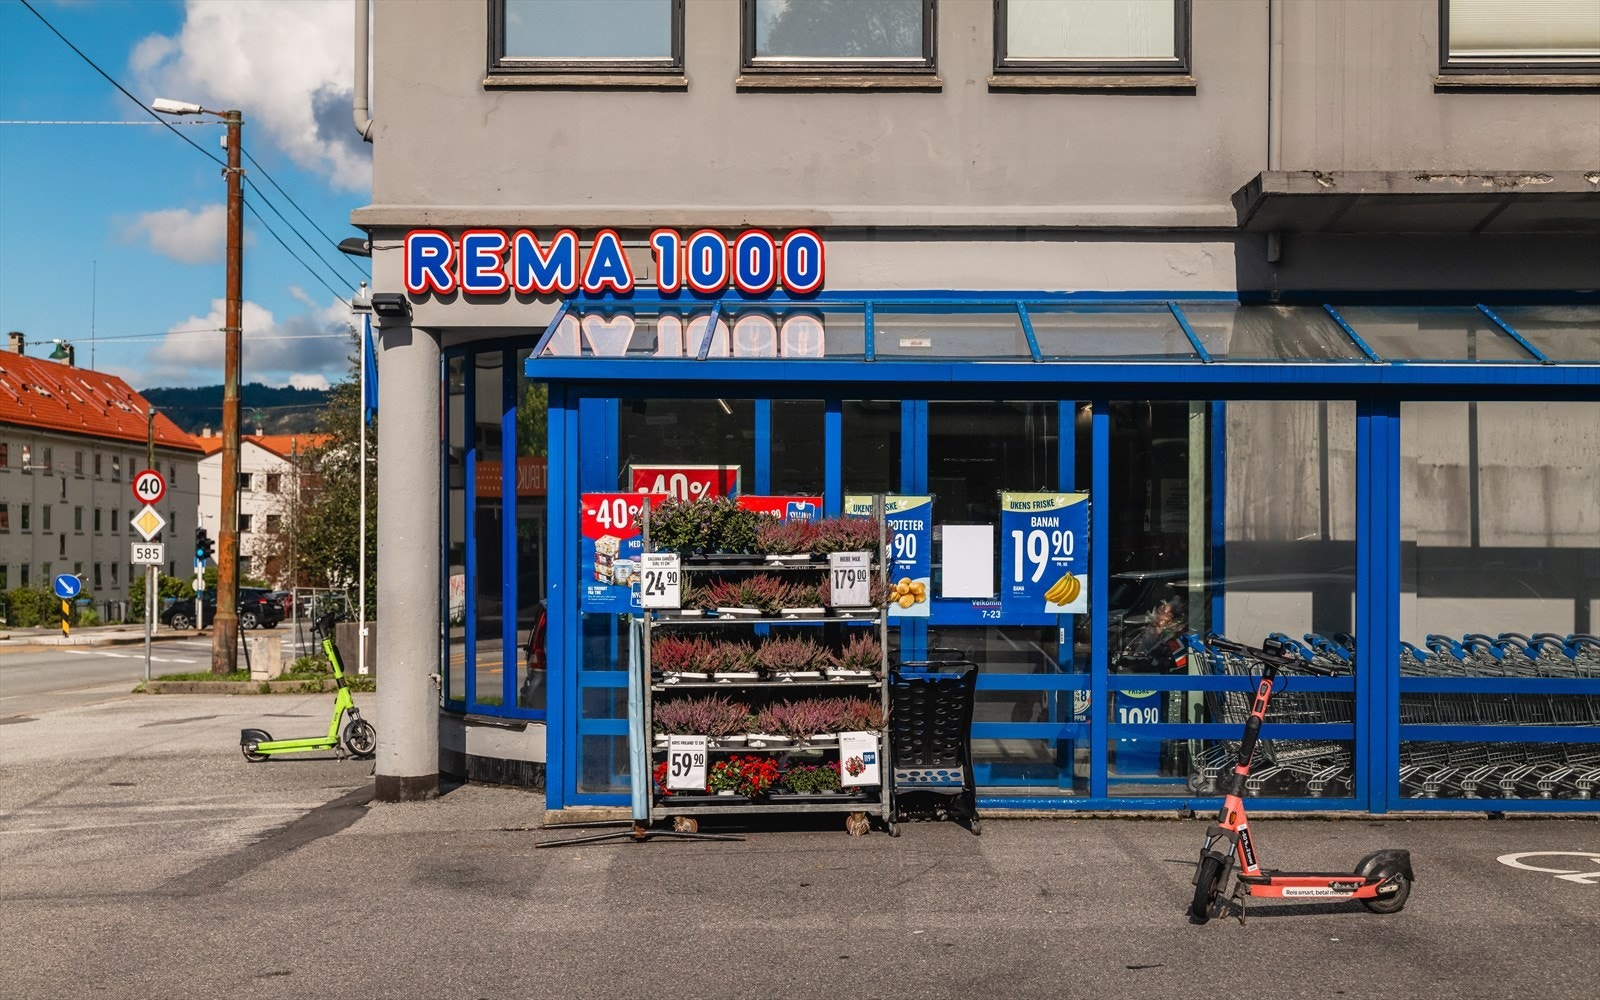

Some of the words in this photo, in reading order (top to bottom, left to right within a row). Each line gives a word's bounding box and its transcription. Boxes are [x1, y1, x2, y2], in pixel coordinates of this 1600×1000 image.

[404, 229, 635, 295] REMA
[649, 229, 826, 294] 1000
[138, 478, 160, 495] 40
[1010, 501, 1031, 510] UKENS
[1033, 499, 1055, 510] FRISKE
[1031, 516, 1059, 528] BANAN
[628, 540, 641, 548] MED
[136, 548, 160, 560] 585
[1011, 529, 1050, 584] 19
[1051, 530, 1074, 556] 90
[645, 570, 666, 596] 24
[667, 571, 678, 583] 90
[834, 569, 856, 590] 179
[857, 569, 867, 580] 00
[671, 752, 693, 777] 59
[693, 753, 704, 765] 90
